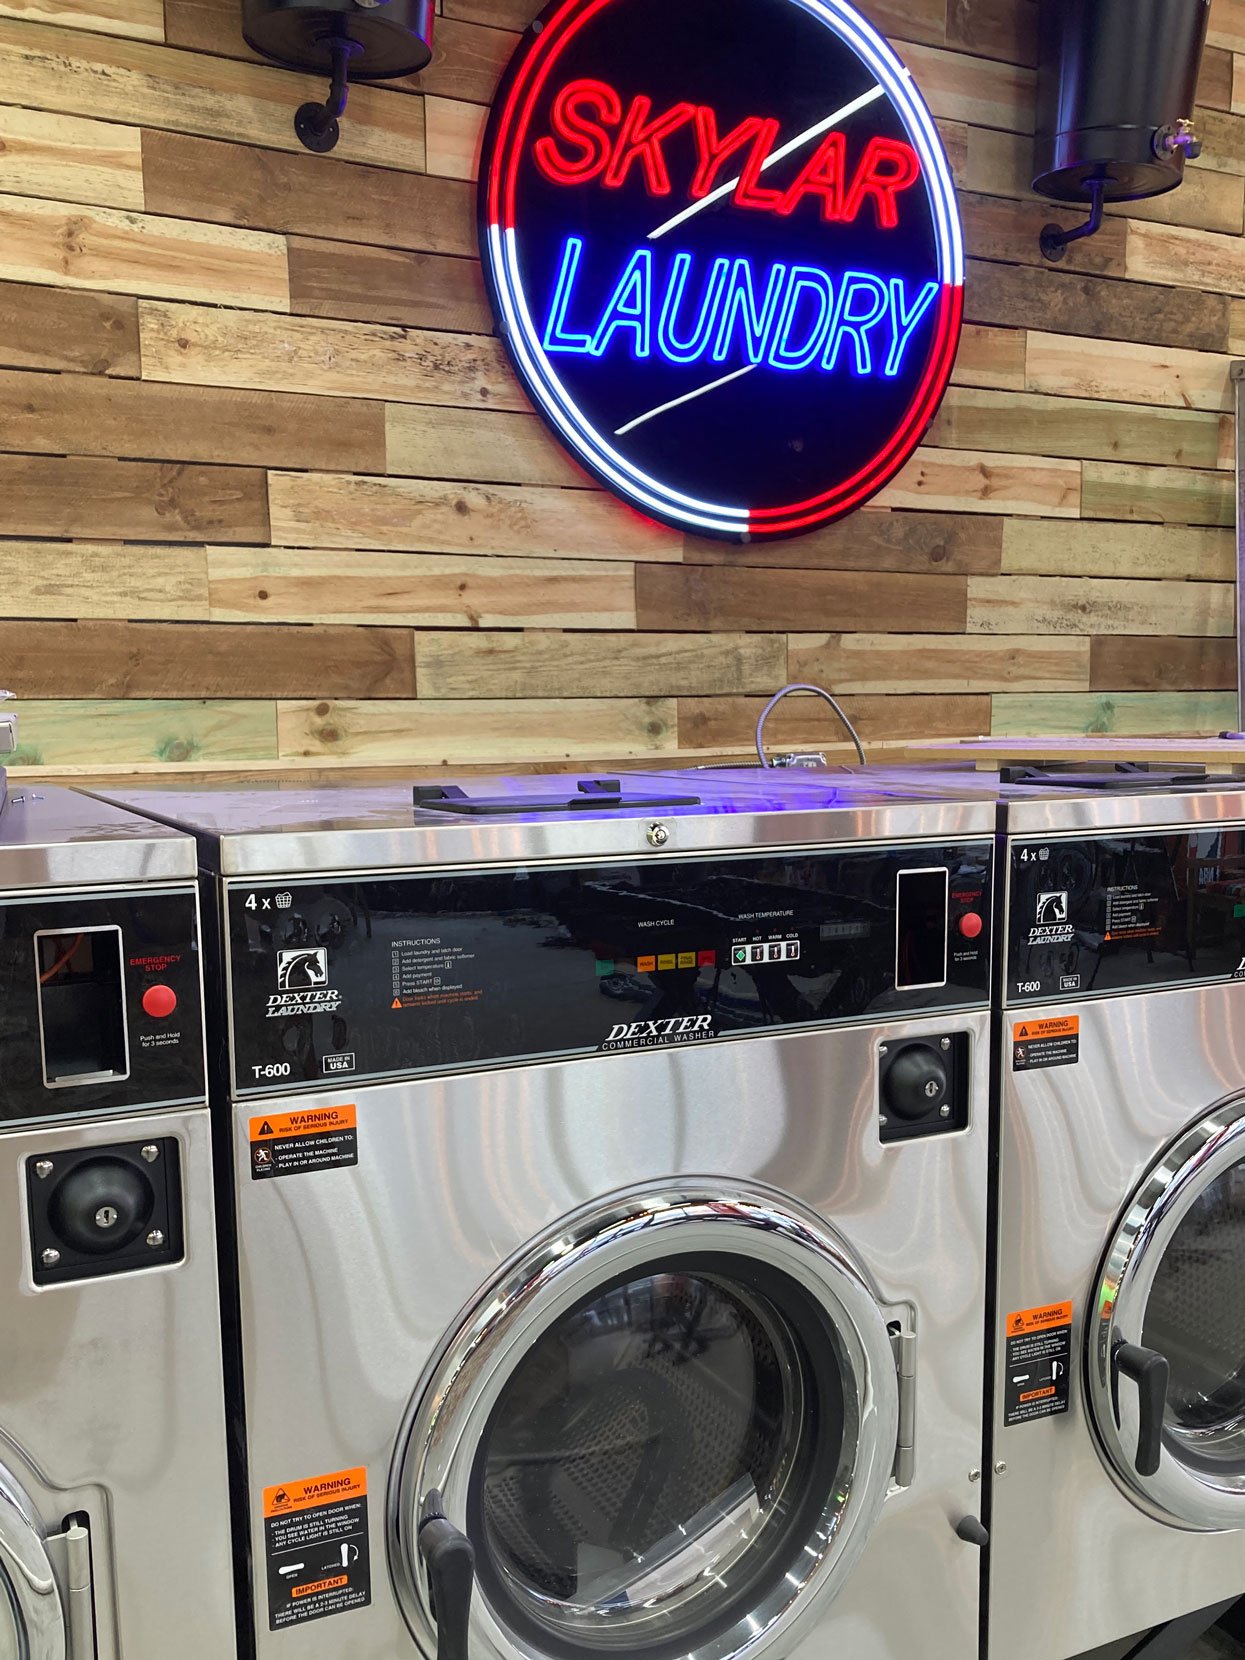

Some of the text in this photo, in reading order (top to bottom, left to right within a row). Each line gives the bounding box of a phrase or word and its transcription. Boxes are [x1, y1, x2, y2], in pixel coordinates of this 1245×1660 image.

[533, 78, 920, 229] SKYLAR
[543, 237, 939, 377] LAUNDRY
[1021, 849, 1028, 861] 4
[245, 894, 271, 910] 4 x
[756, 910, 793, 918] TEMPERATURE
[1029, 925, 1073, 937] DEXTER
[392, 938, 440, 947] INSTRUCTIONS
[1028, 934, 1074, 945] LAUNDRY
[130, 955, 180, 966] EMERGENCY
[1017, 981, 1040, 993] T-600
[266, 989, 339, 1006] DEXTER
[266, 1001, 341, 1017] LAUNDRY
[605, 1014, 712, 1041] DEXTER
[1038, 1020, 1068, 1029] WARNING
[602, 1031, 714, 1050] COMMERCIAL WASHER
[252, 1063, 290, 1078] T-600
[330, 1062, 348, 1070] USA
[290, 1112, 338, 1125] WARNING
[316, 1136, 343, 1145] CHILDREN
[279, 1152, 302, 1160] OPERATE
[315, 1147, 338, 1155] MACHINE
[309, 1156, 330, 1164] AROUND
[332, 1152, 353, 1160] MACHINE
[1032, 1309, 1062, 1320] WARNING
[304, 1478, 350, 1494] WARNING
[317, 1488, 340, 1497] SERIOUS
[342, 1484, 360, 1492] INJURY
[328, 1507, 343, 1515] DOOR
[287, 1525, 302, 1533] DRUM
[310, 1520, 323, 1528] STILL
[325, 1515, 348, 1524] TURNING
[300, 1527, 318, 1535] WATER
[337, 1518, 359, 1527] WINDOW
[288, 1536, 305, 1544] CYCLE
[307, 1532, 321, 1540] LIGHT
[329, 1527, 343, 1535] STILL
[296, 1578, 343, 1595] IMPORTANT
[275, 1610, 292, 1618] THERE
[294, 1606, 305, 1614] WILL
[329, 1596, 347, 1605] MINUTE
[349, 1591, 365, 1600] DELAY
[292, 1598, 311, 1606] POWER
[276, 1615, 296, 1624] BEFORE
[309, 1607, 324, 1616] DOOR
[344, 1597, 365, 1606] OPENED
